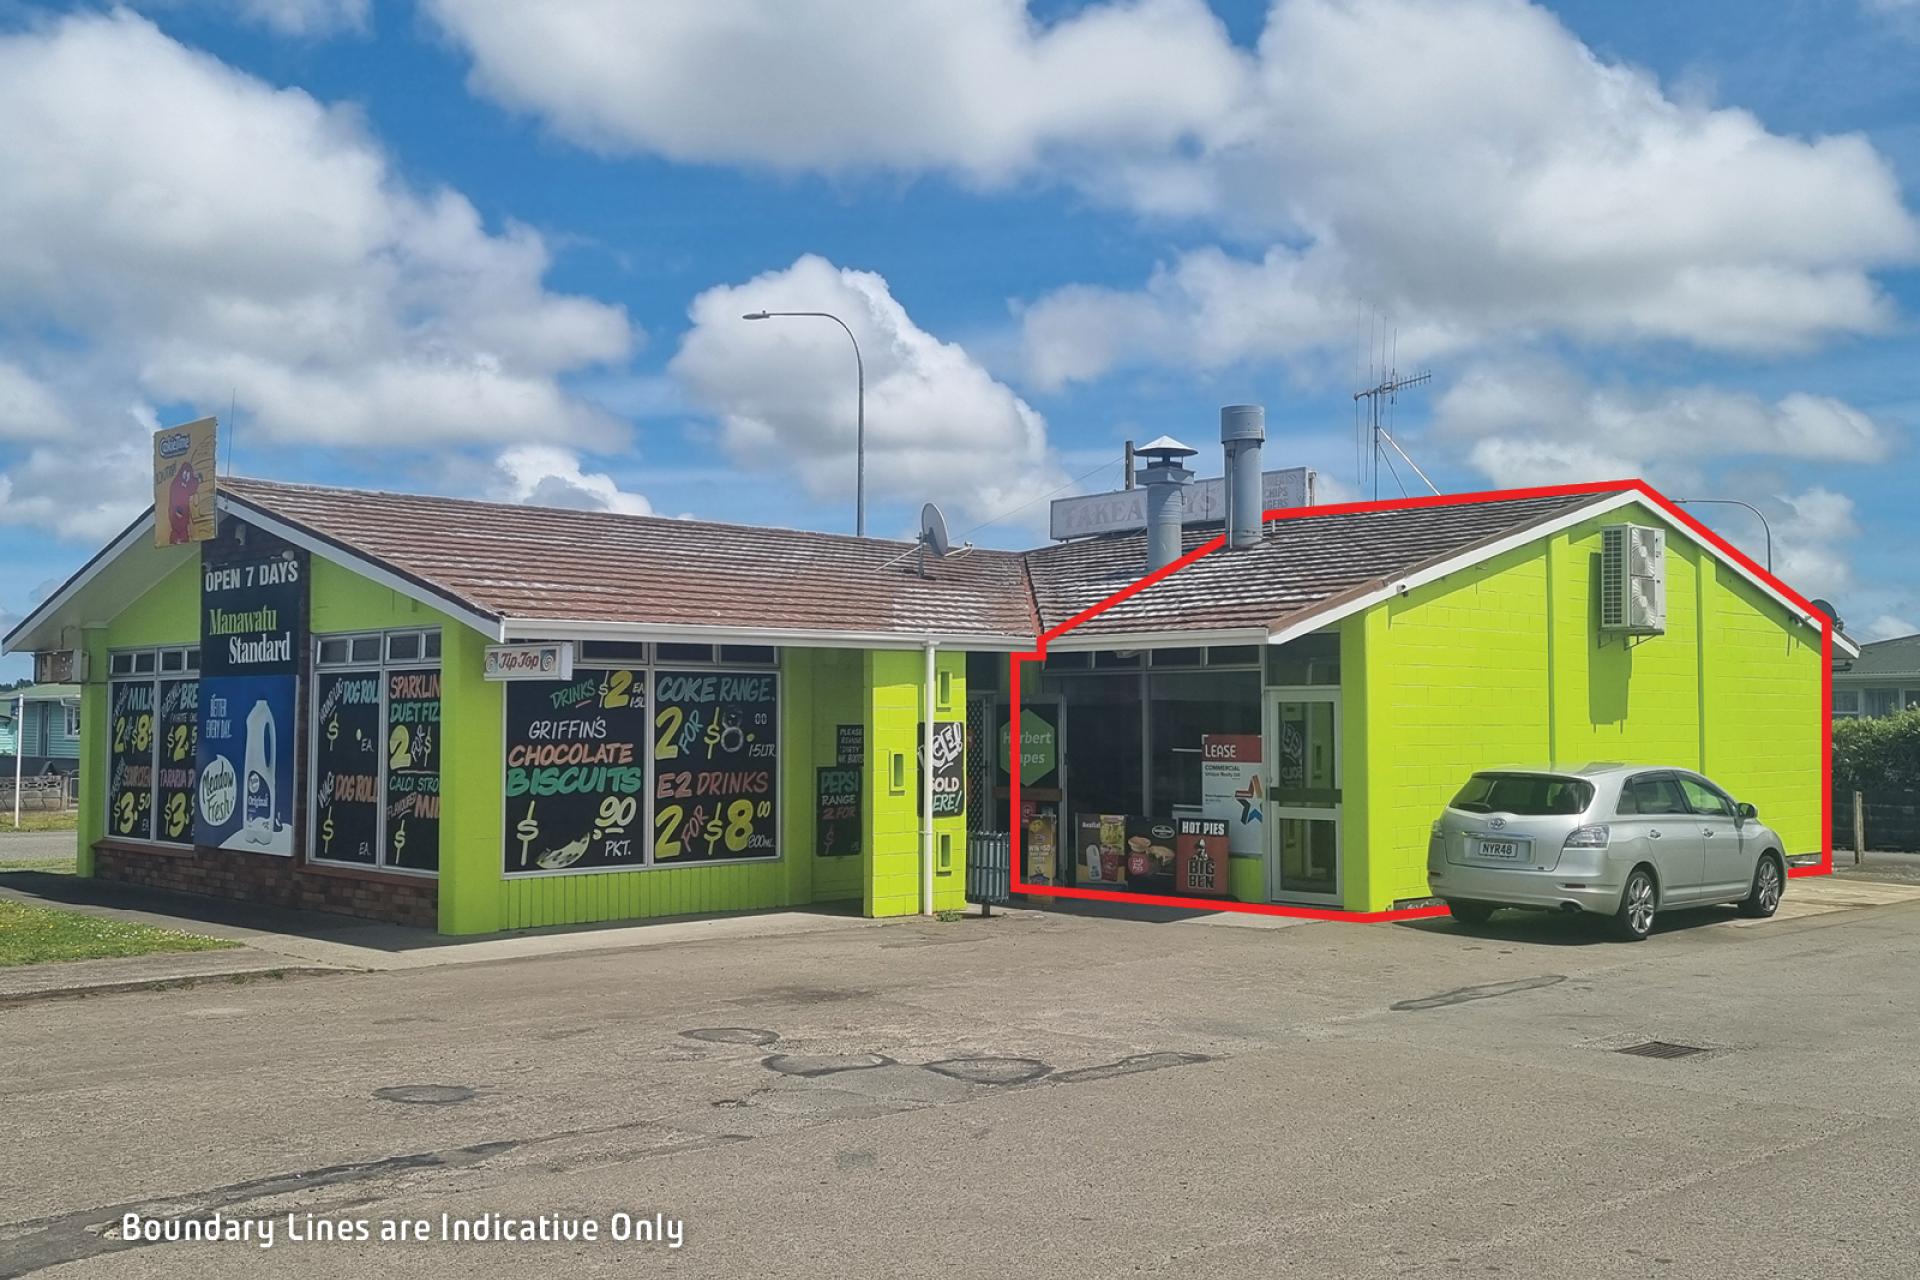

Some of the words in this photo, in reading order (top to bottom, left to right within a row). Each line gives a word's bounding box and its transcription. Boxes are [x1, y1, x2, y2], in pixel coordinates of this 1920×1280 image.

[205, 568, 240, 592] OPEN
[245, 566, 255, 587] 7
[259, 560, 298, 586] DAYS
[209, 605, 277, 635] Manawatu
[228, 631, 291, 664] Standard
[499, 652, 517, 671] Tip
[517, 651, 540, 670] Top
[342, 680, 360, 705] DOG
[550, 678, 596, 709] DRINKS
[656, 676, 717, 703] COKE
[390, 702, 420, 723] DUET
[528, 716, 607, 740] GRIFFIN'S
[655, 706, 683, 760] 2
[678, 709, 704, 755] FOR
[1003, 730, 1052, 745] Hrbert
[389, 725, 412, 770] 2
[508, 743, 634, 767] CHOCOLATE
[1205, 744, 1237, 759] LEASE
[1204, 764, 1240, 772] COMMERCIAL
[203, 762, 234, 804] Meadow
[335, 774, 355, 801] DOG
[506, 766, 642, 797] BISCUITS
[656, 771, 693, 799] E2
[696, 771, 769, 796] DRINKS
[821, 770, 860, 794] PEPSI
[932, 776, 960, 793] OLD
[821, 794, 857, 806] RANGE
[932, 790, 962, 814] ERE!
[655, 804, 683, 859] 2
[681, 804, 709, 853] FOR
[1182, 820, 1201, 834] HOT
[1202, 821, 1225, 836] PIES
[1482, 842, 1513, 856] NYR48
[1188, 859, 1216, 875] BIG
[1188, 874, 1215, 888] BEN
